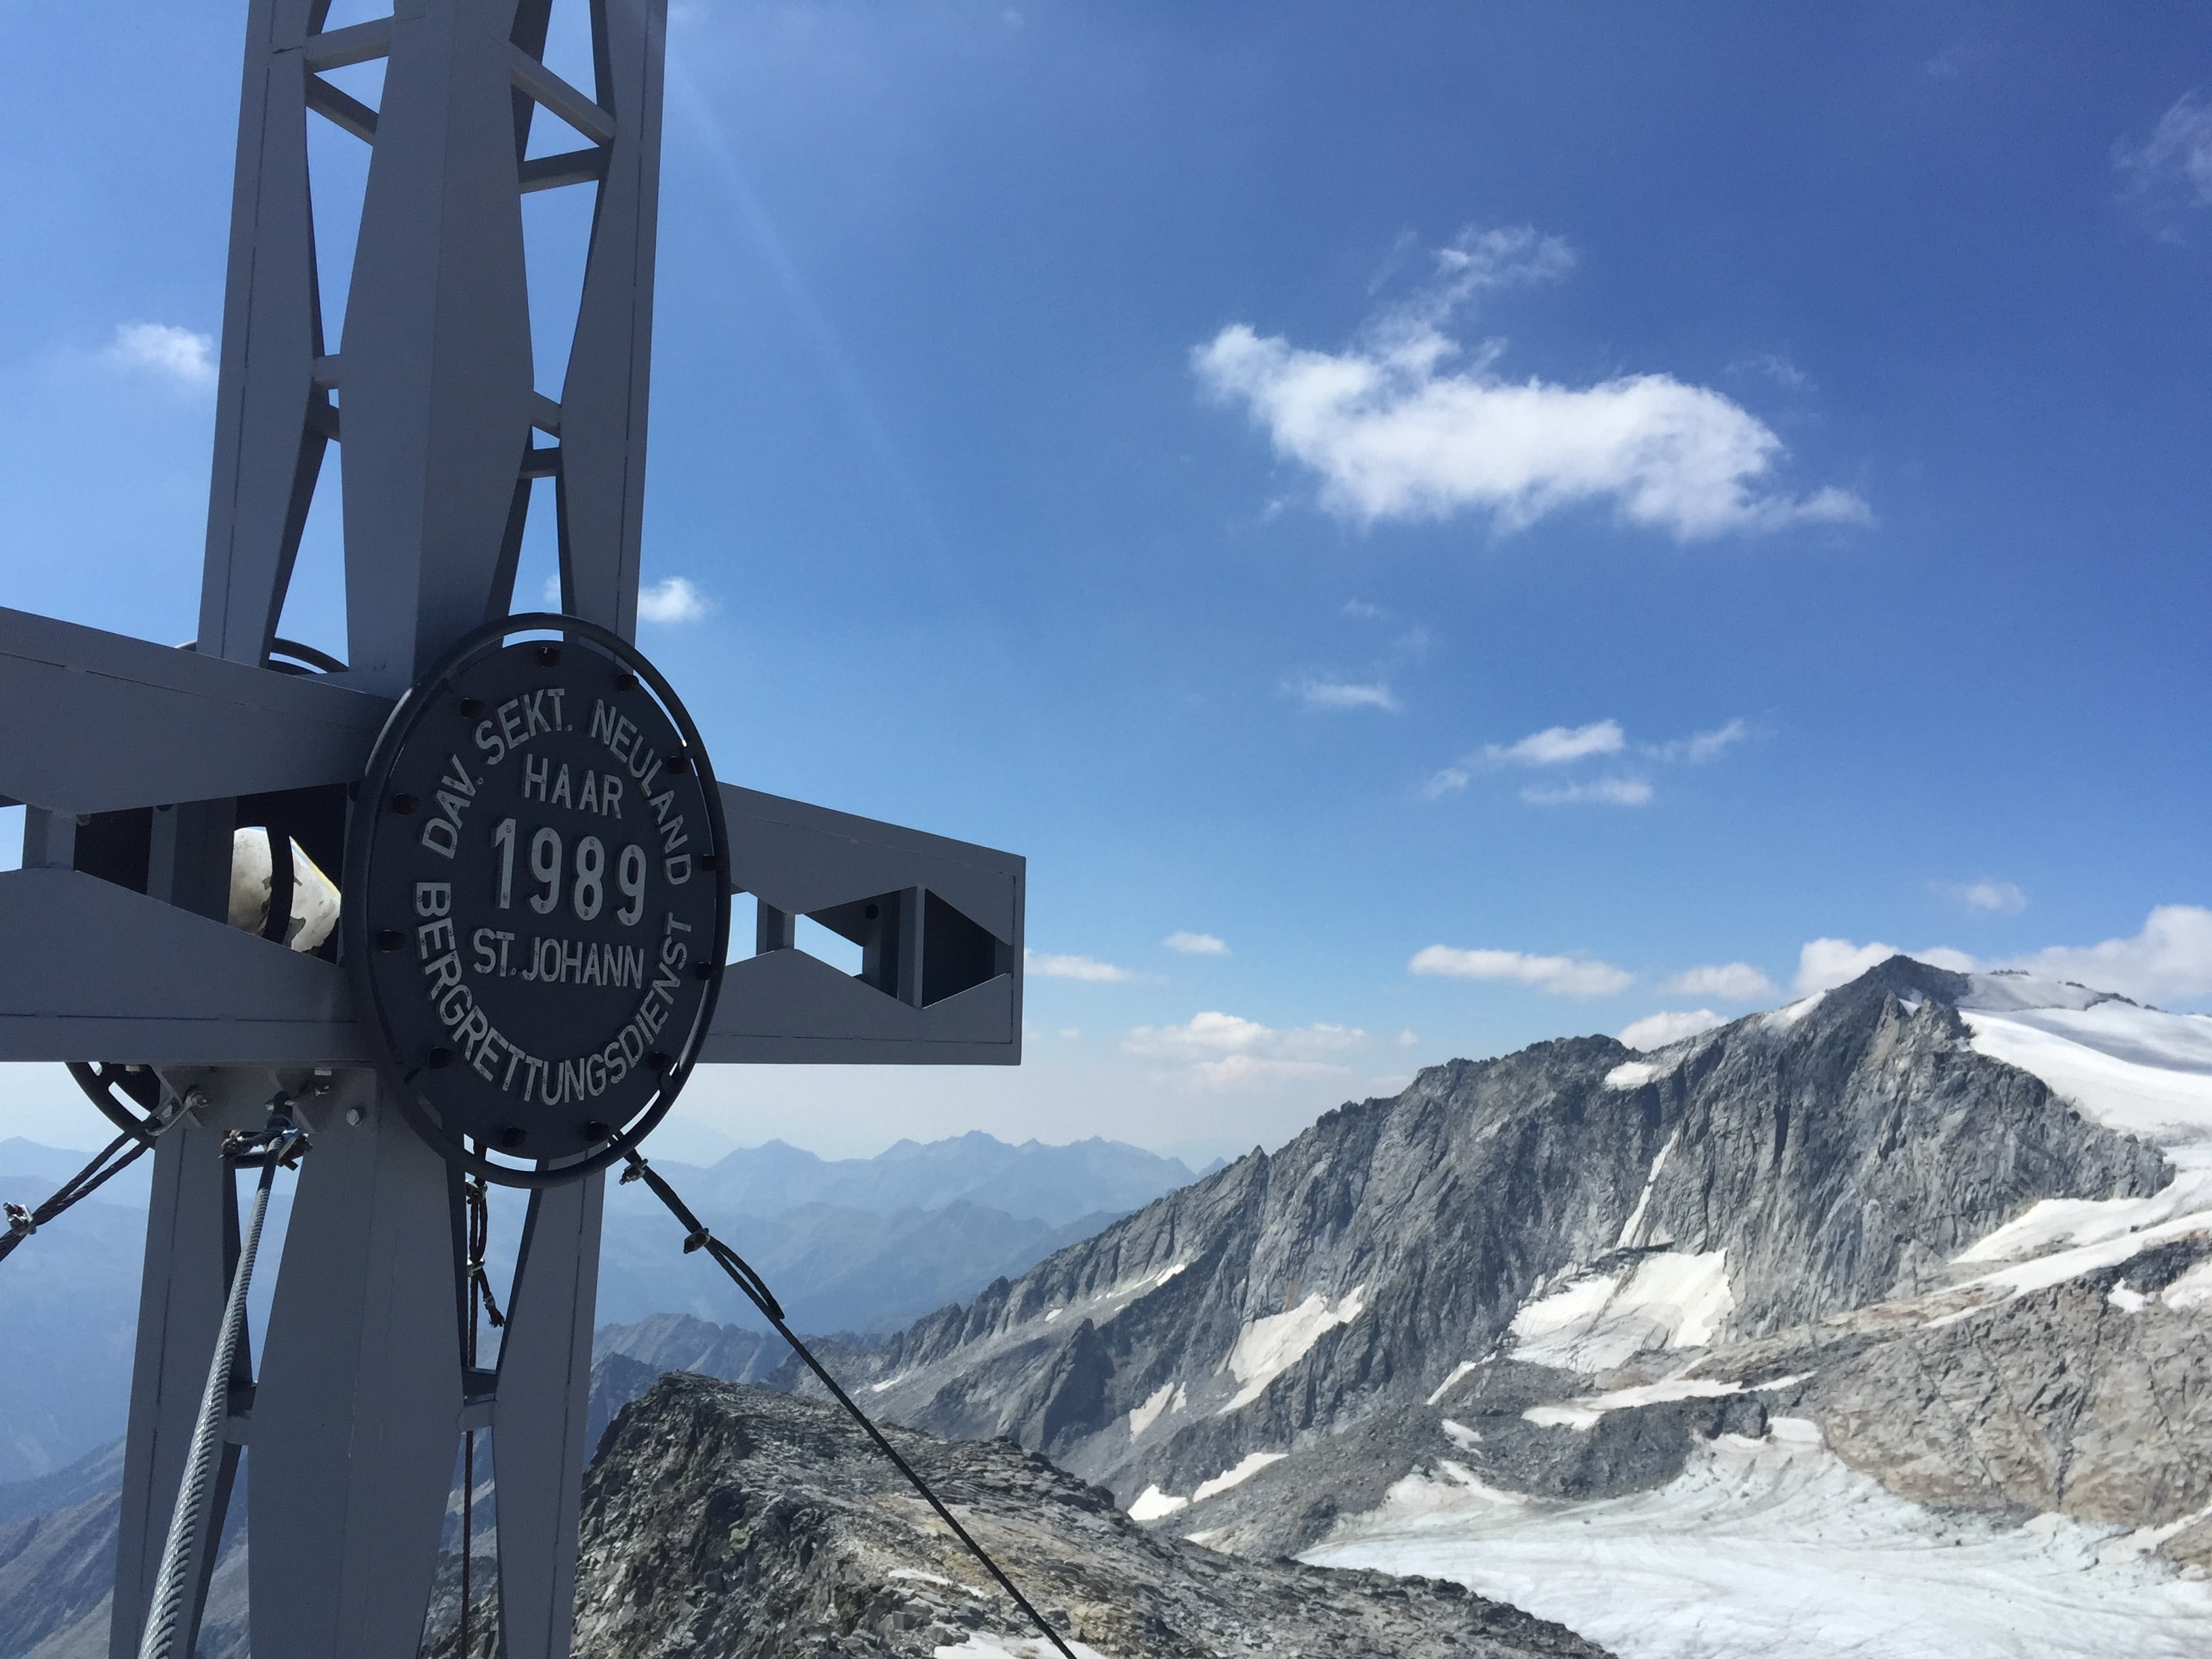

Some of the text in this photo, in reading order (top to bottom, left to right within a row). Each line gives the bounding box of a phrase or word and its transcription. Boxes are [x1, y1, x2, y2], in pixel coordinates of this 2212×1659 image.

[422, 689, 692, 885] DAV. SEKT. NEULAND
[524, 754, 623, 818] HAAR
[492, 818, 647, 926] 1989
[415, 882, 692, 1106] BERGRETTUNGSDIENST
